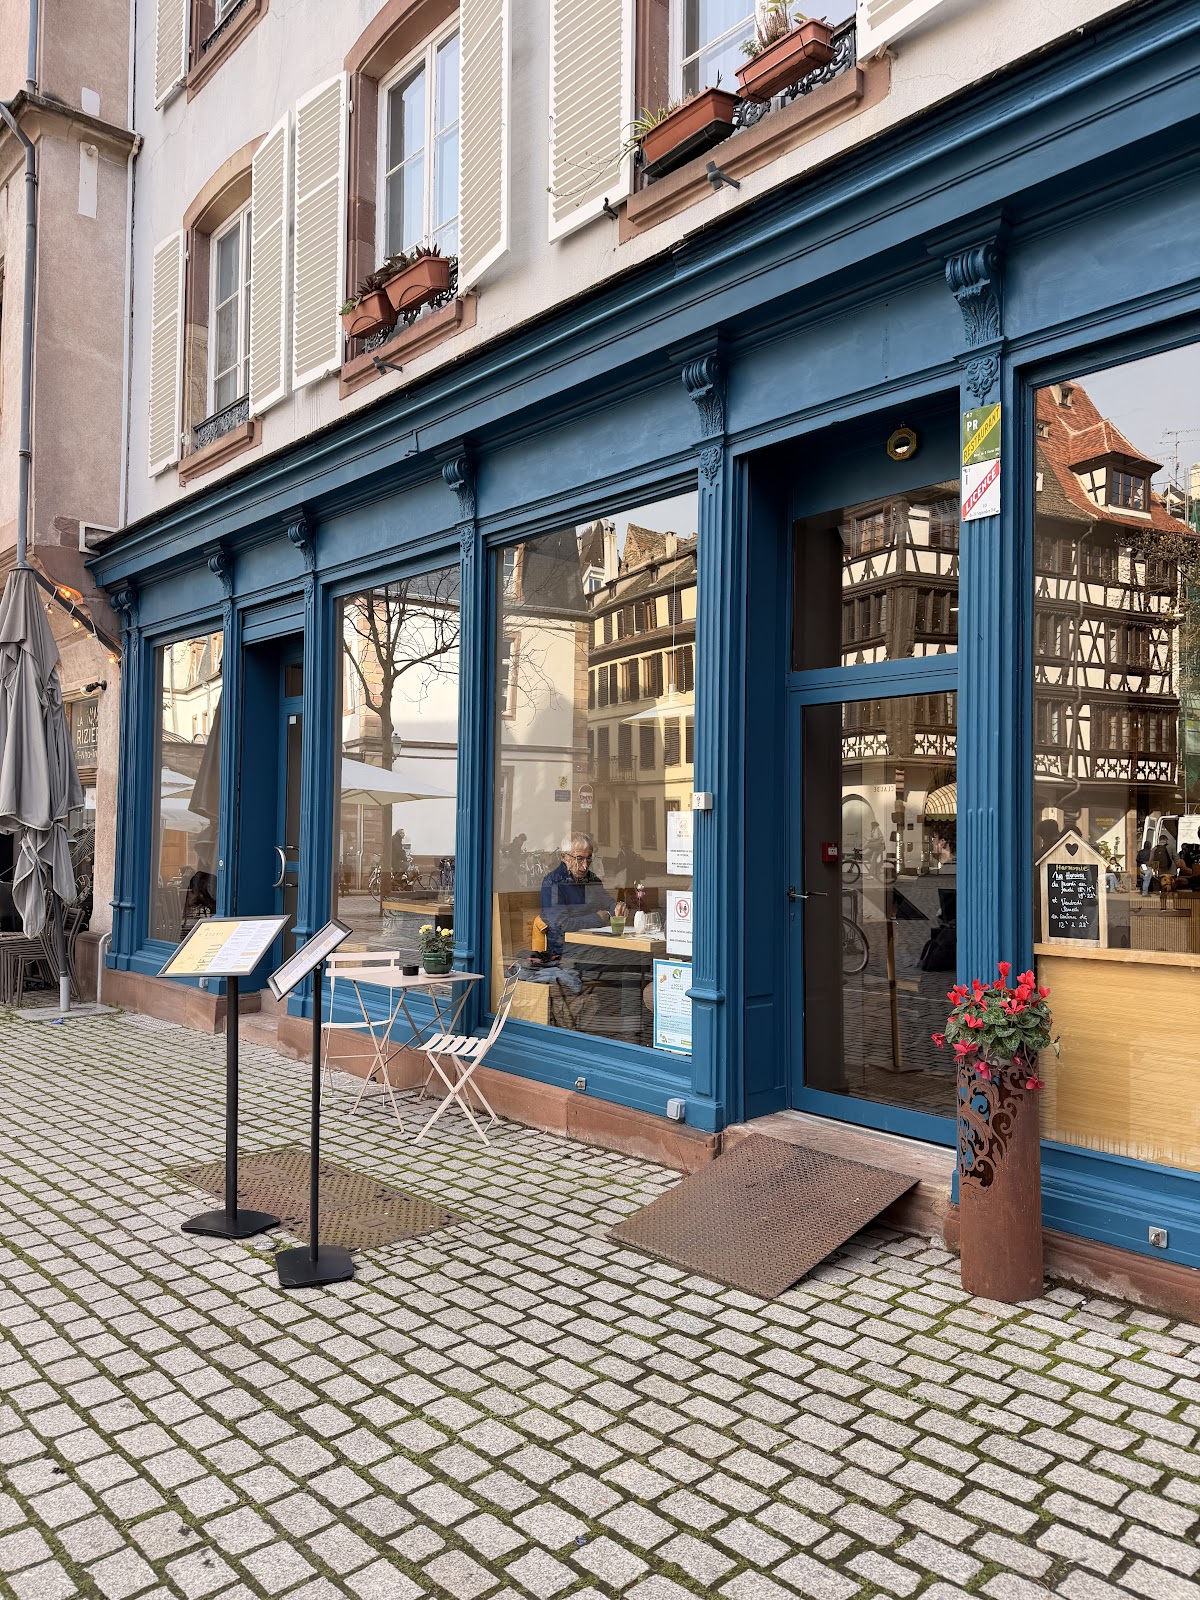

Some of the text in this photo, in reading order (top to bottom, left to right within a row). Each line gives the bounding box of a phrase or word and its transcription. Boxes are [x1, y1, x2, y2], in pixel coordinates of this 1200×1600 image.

[963, 404, 1000, 462] RESTAURANT
[966, 419, 979, 432] PR
[966, 466, 997, 513] LICENCE
[77, 717, 83, 726] LA
